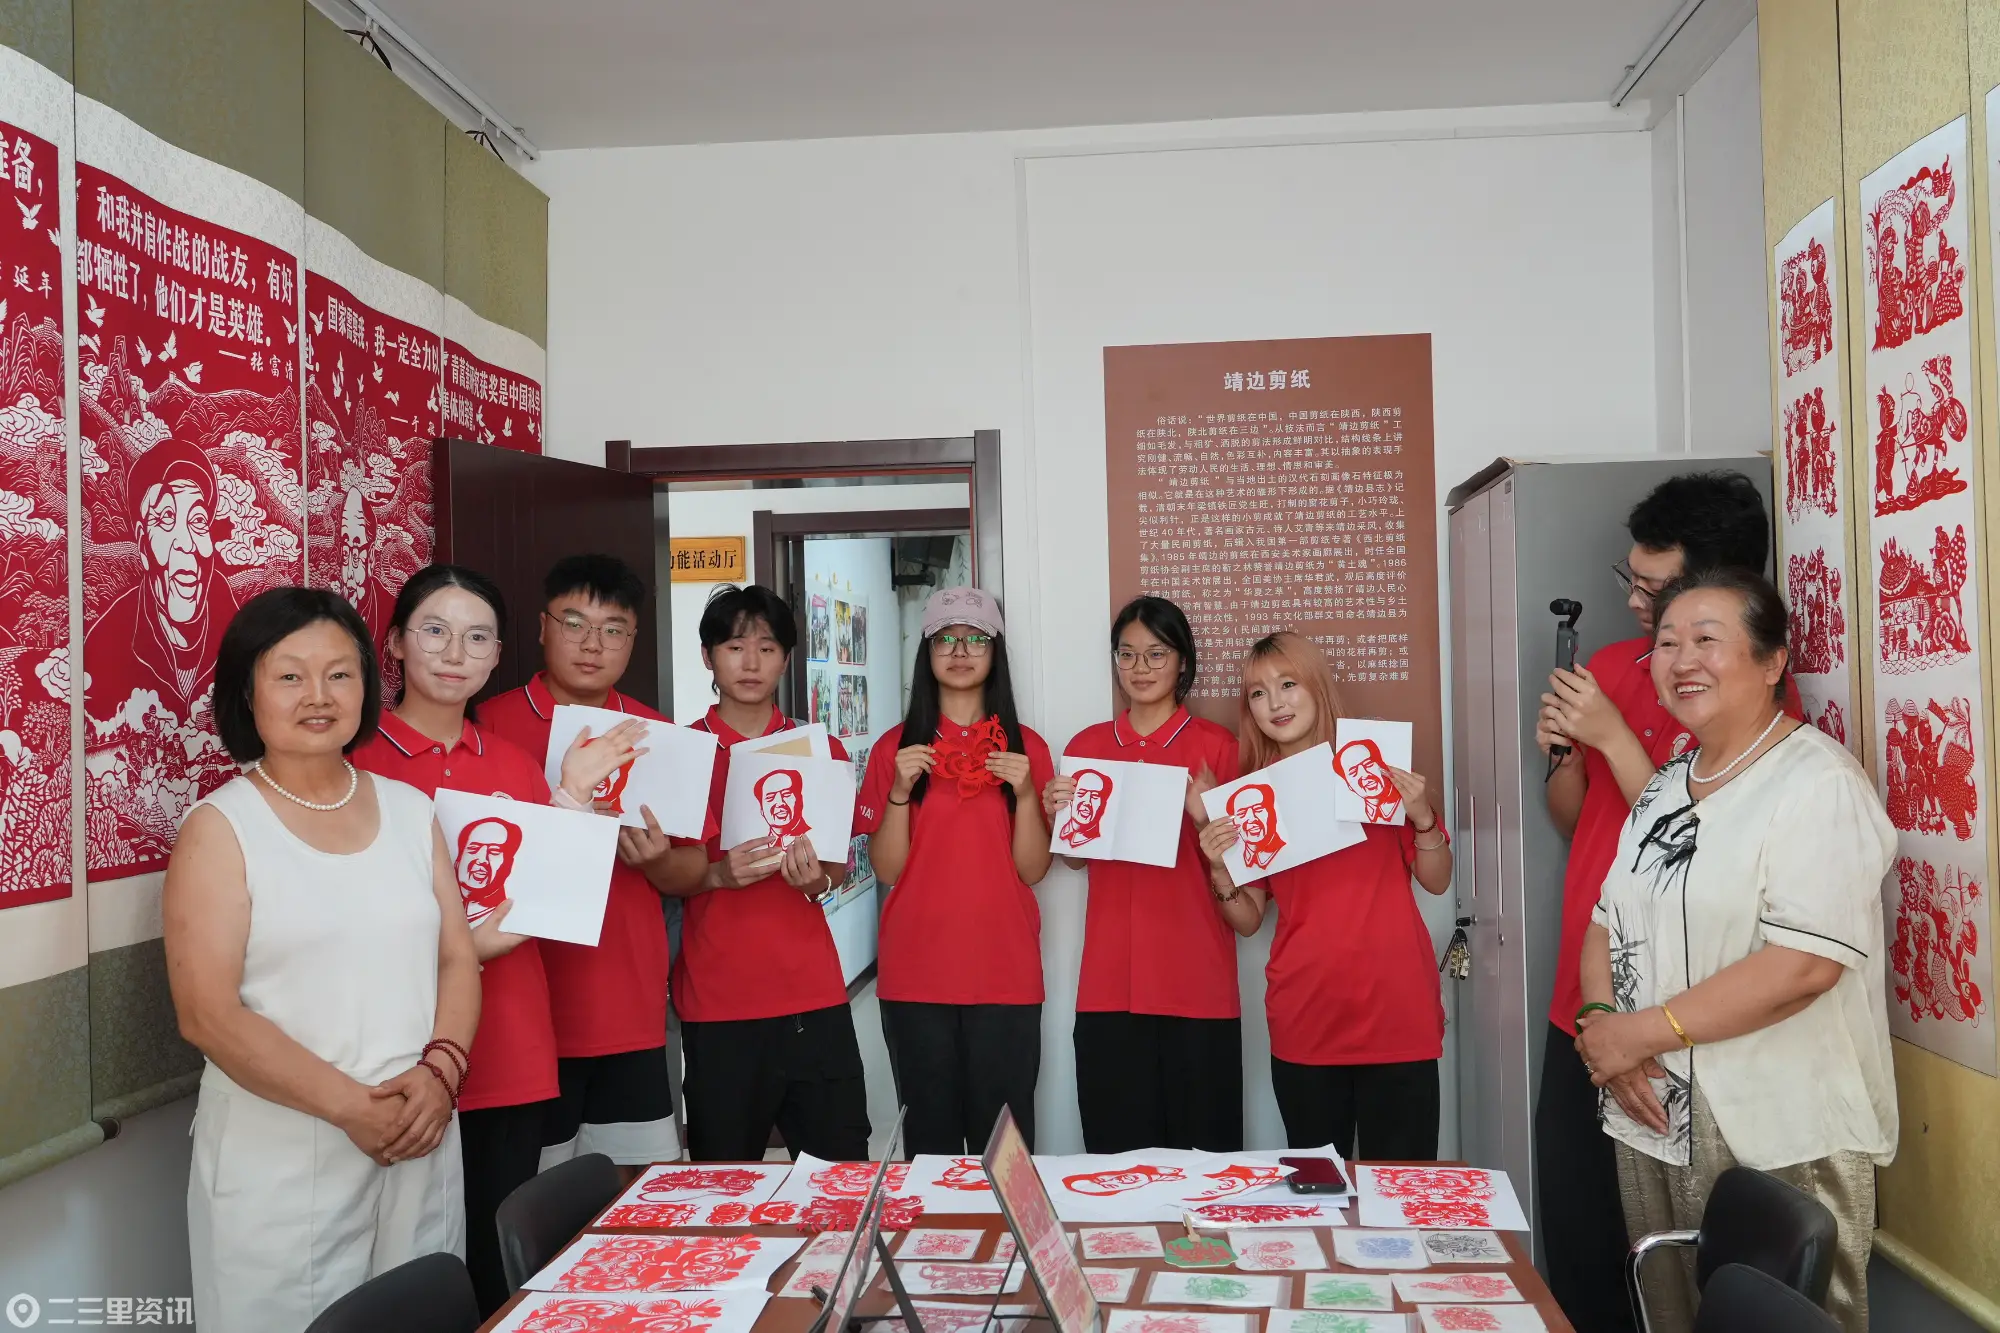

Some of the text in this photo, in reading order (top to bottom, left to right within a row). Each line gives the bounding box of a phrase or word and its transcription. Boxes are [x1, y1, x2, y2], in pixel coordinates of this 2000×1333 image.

[96, 186, 293, 306] 和我并肩作战的战友，有好
[0, 264, 52, 299] 延年
[327, 295, 440, 376] 国家需要我，我一定全力以
[1223, 369, 1311, 392] 靖边剪纸
[1194, 637, 1264, 648] 纸是先用铅笔
